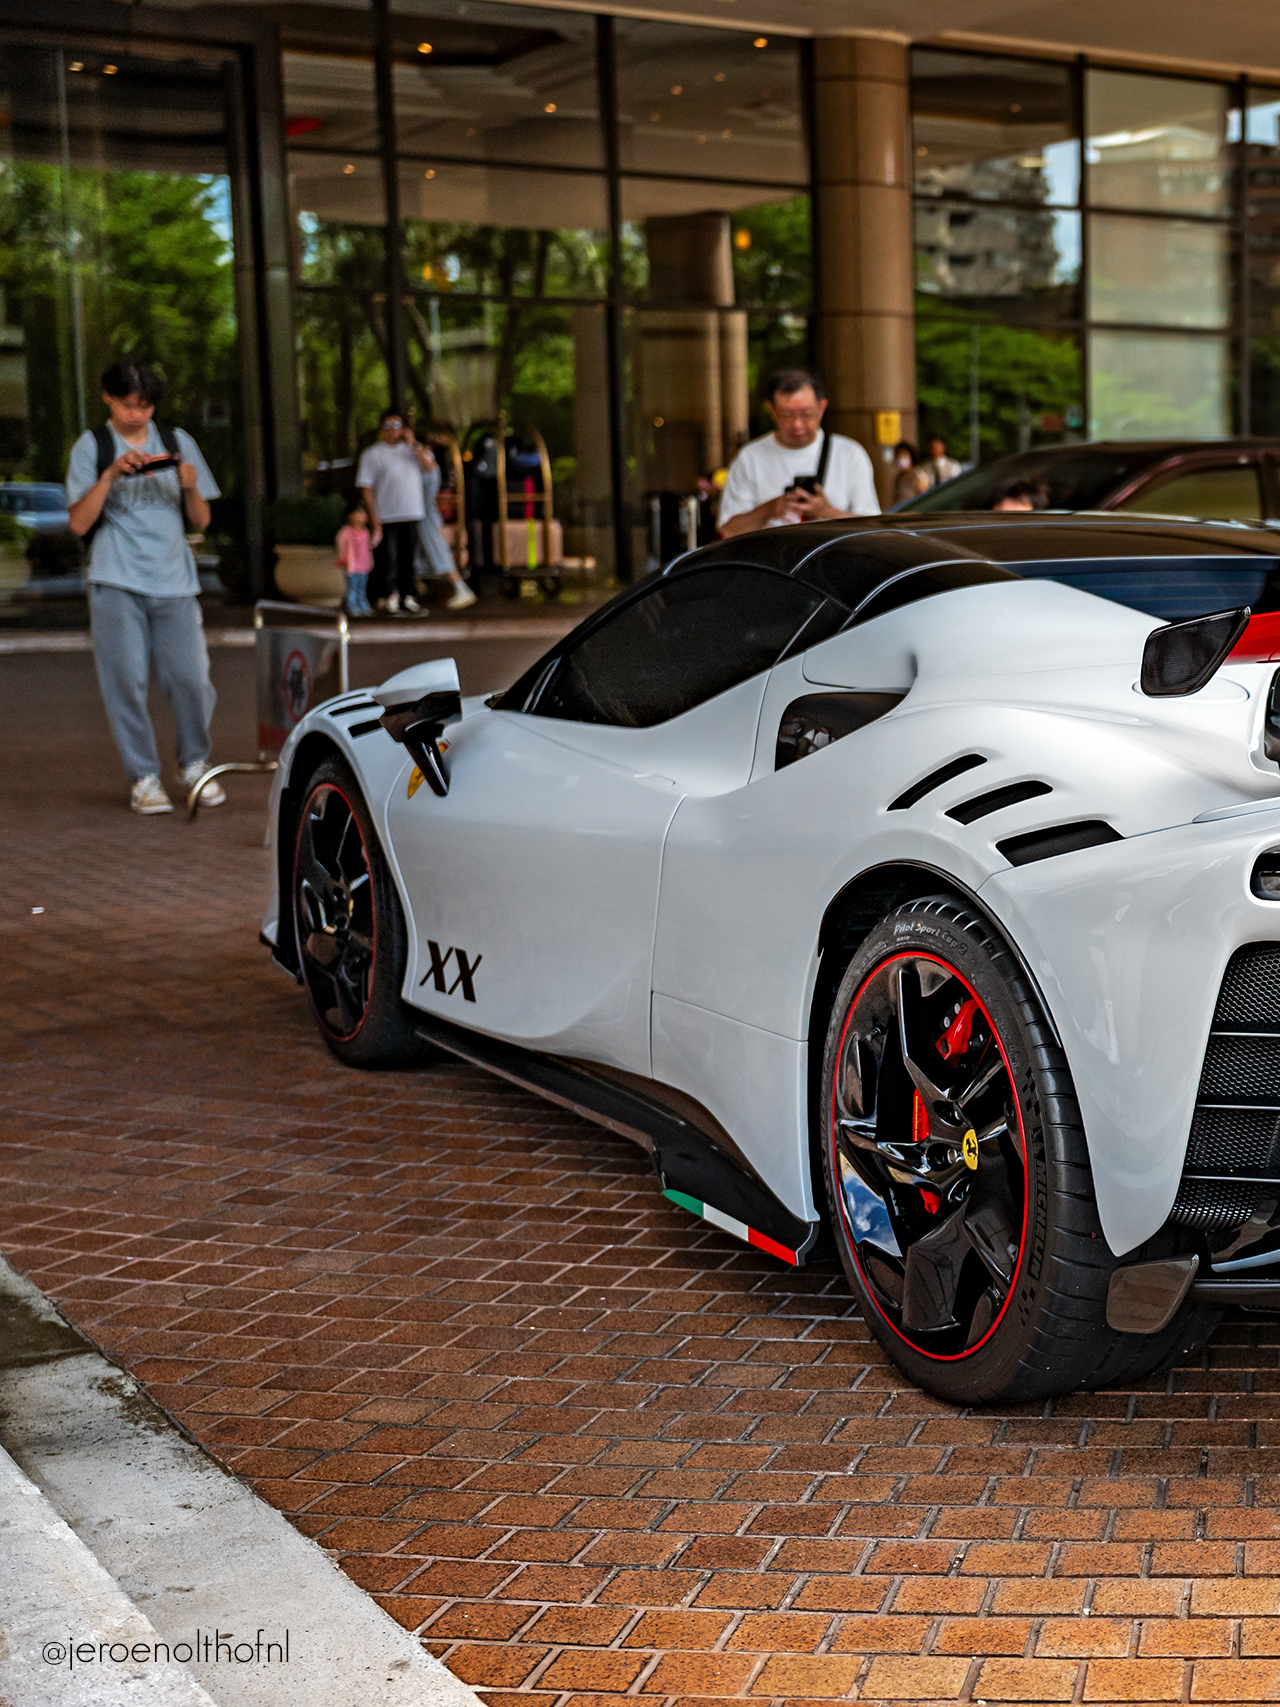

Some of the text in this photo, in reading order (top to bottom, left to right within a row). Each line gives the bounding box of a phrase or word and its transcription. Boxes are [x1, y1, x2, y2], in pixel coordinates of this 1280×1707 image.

[419, 939, 483, 1004] XX
[894, 922, 915, 935] Pilot
[915, 922, 940, 937] Sport
[941, 930, 958, 949] Cup
[958, 943, 968, 957] 2
[1027, 1159, 1048, 1282] MICHELIN
